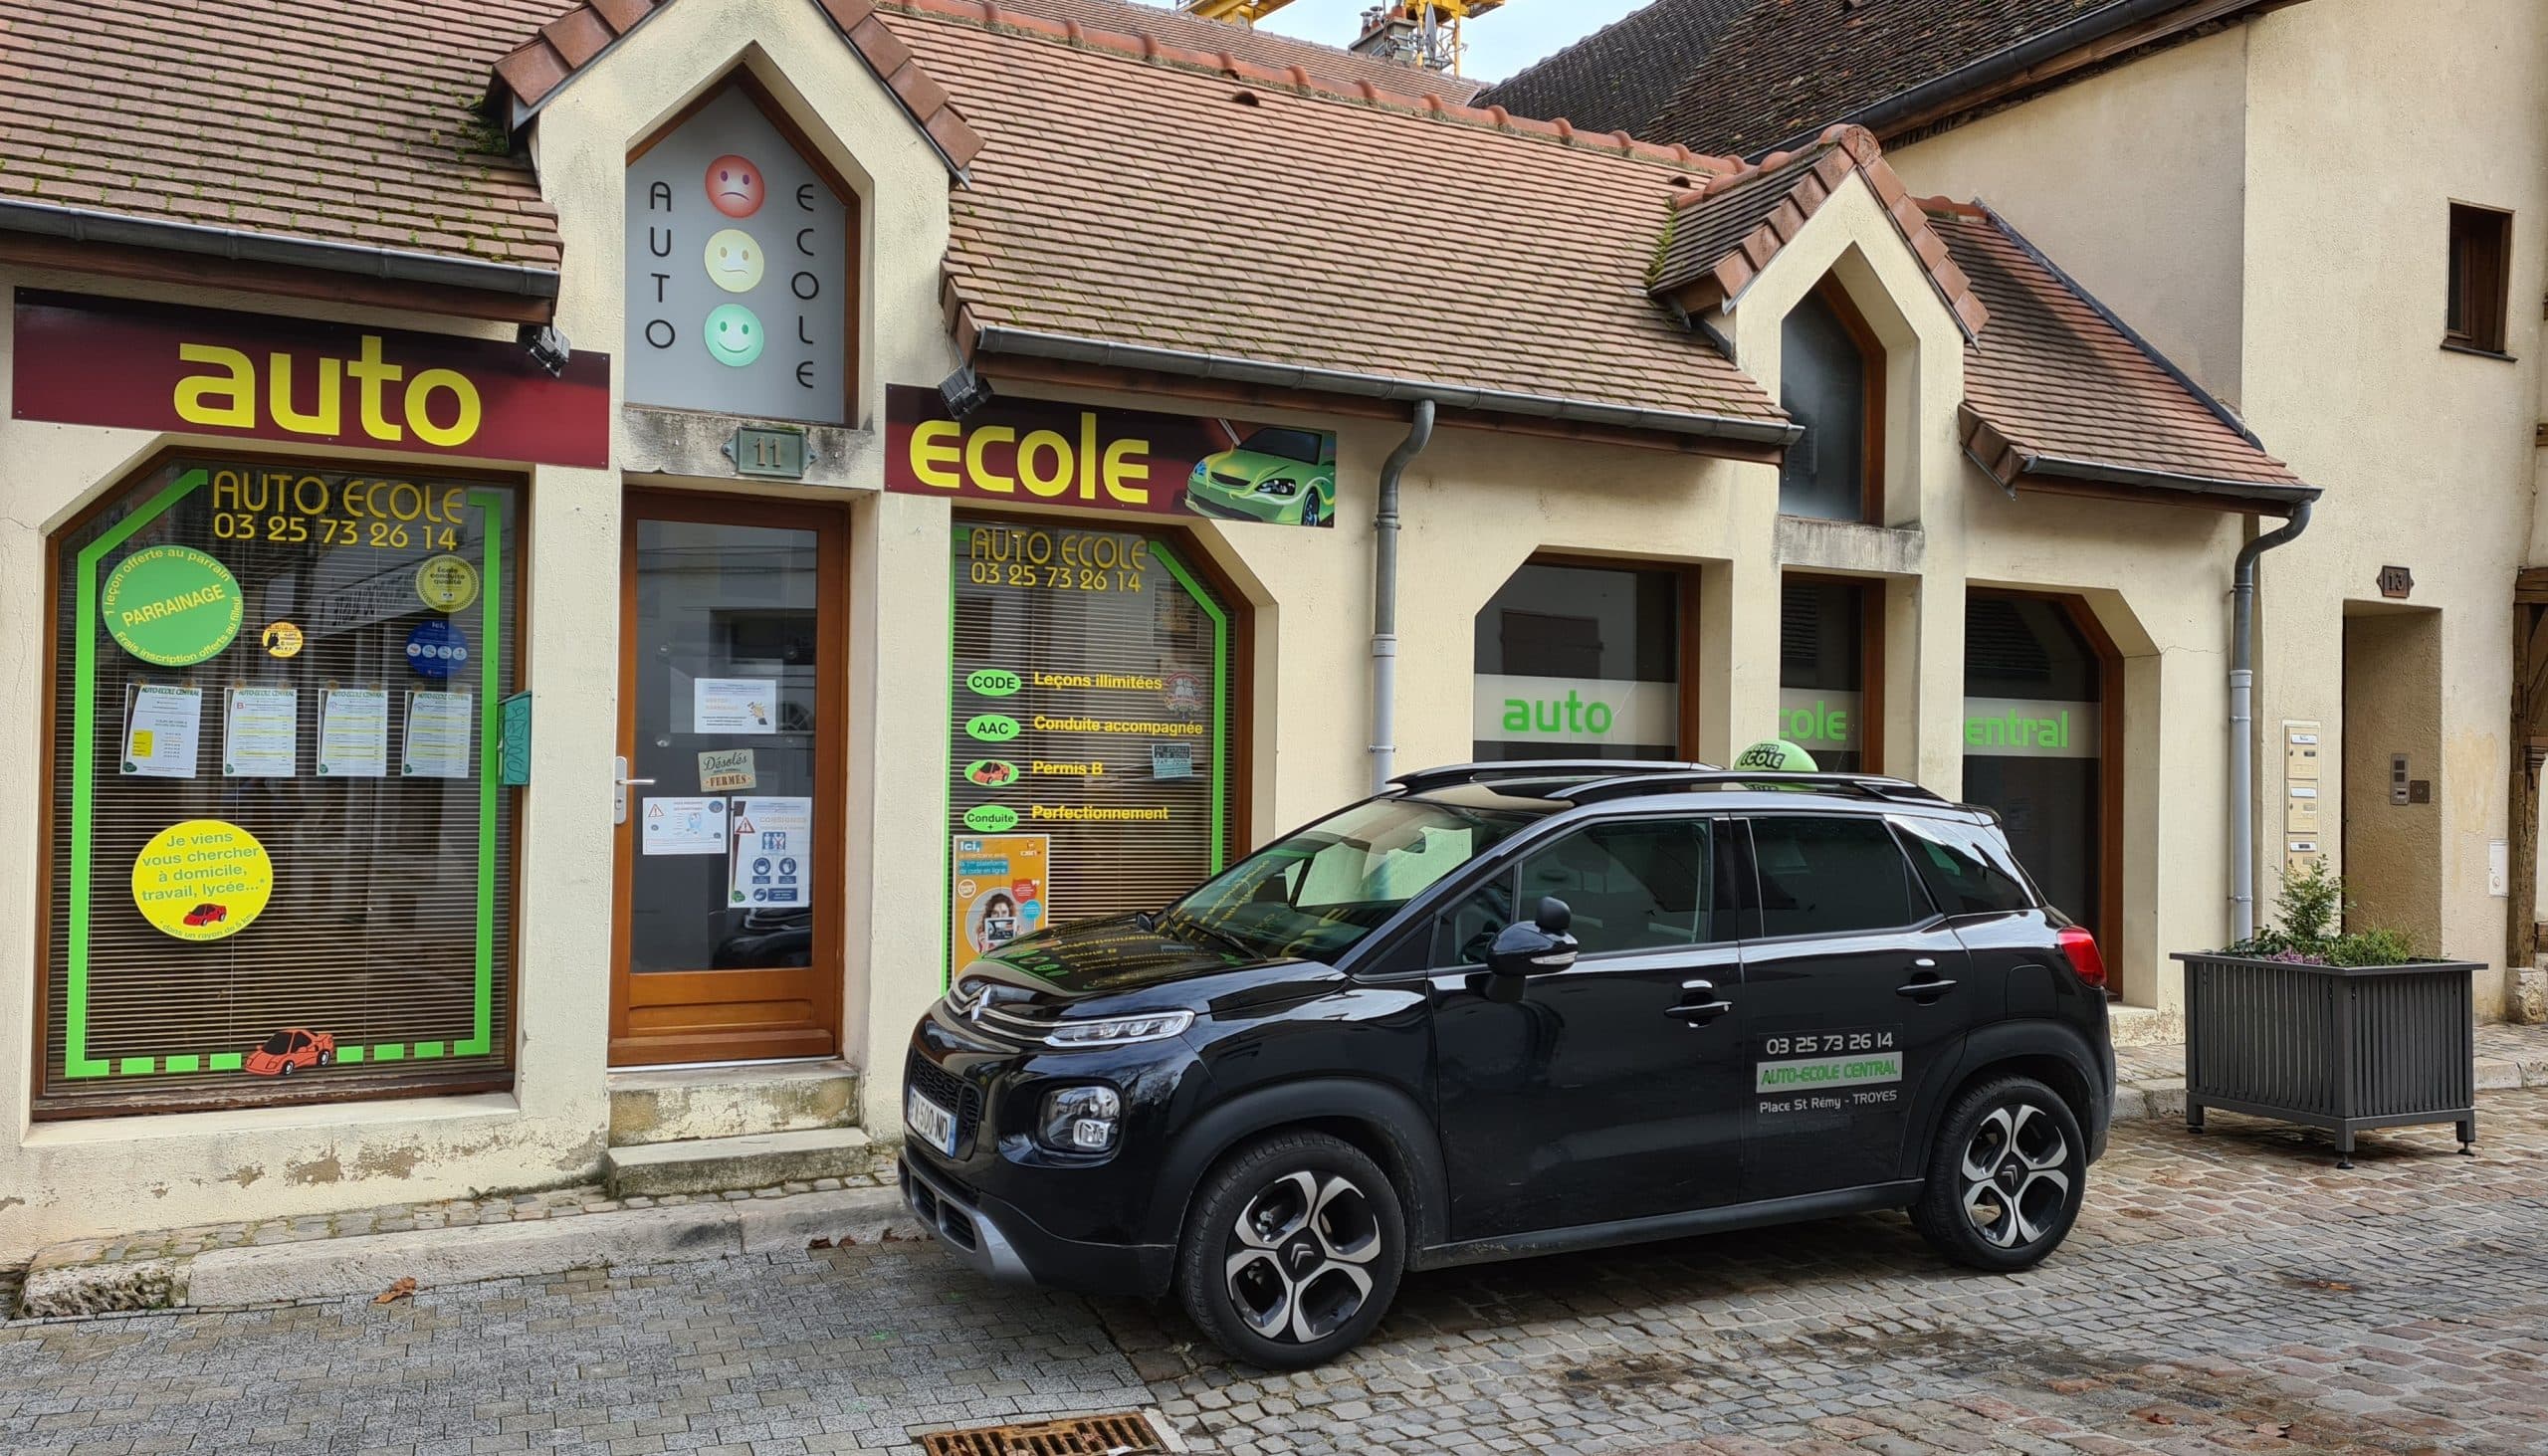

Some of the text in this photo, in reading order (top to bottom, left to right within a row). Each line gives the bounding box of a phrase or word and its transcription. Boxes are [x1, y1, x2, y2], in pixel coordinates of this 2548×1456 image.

[645, 181, 675, 349] AUTO
[791, 184, 819, 388] ECOLE
[173, 335, 482, 447] auto
[753, 436, 781, 467] 11
[213, 470, 463, 524] AUTO ECOLE
[213, 513, 458, 551] 03 25 73 26 14
[970, 526, 1147, 571] AUTO ECOLE
[107, 573, 124, 606] leçon
[123, 549, 163, 574] offerte
[187, 552, 231, 582] parrain
[970, 562, 1142, 593] 03 25 73 26 14
[2389, 572, 2404, 591] 13
[121, 583, 226, 627] PARRAINAGE
[116, 596, 242, 665] Frais inscription offerts au filleul
[971, 675, 1016, 690] CODE
[1034, 672, 1163, 691] Leçons illimitées
[1503, 690, 1612, 734] auto
[977, 722, 1009, 734] AAC
[1034, 716, 1203, 736] Conduite accompagnée
[704, 751, 747, 771] Désolés
[1032, 760, 1103, 775] Permis B
[966, 812, 1014, 824] Conduite
[1031, 805, 1168, 820] Perfectionnement
[166, 833, 233, 847] Je viens
[959, 841, 980, 852] Ici,
[142, 847, 260, 867] vous chercher
[158, 865, 248, 883] à domicile,
[141, 886, 198, 902] travail,
[163, 925, 182, 936] dans
[198, 931, 223, 939] rayon
[1766, 1032, 1893, 1055] 03 25 73 26 14
[1761, 1059, 1897, 1085] AUTO-ECOLE CENTRAL
[1760, 1101, 1791, 1114] Place
[1794, 1098, 1807, 1111] St
[1811, 1096, 1841, 1110] Rémy
[1852, 1090, 1897, 1105] TROYES
